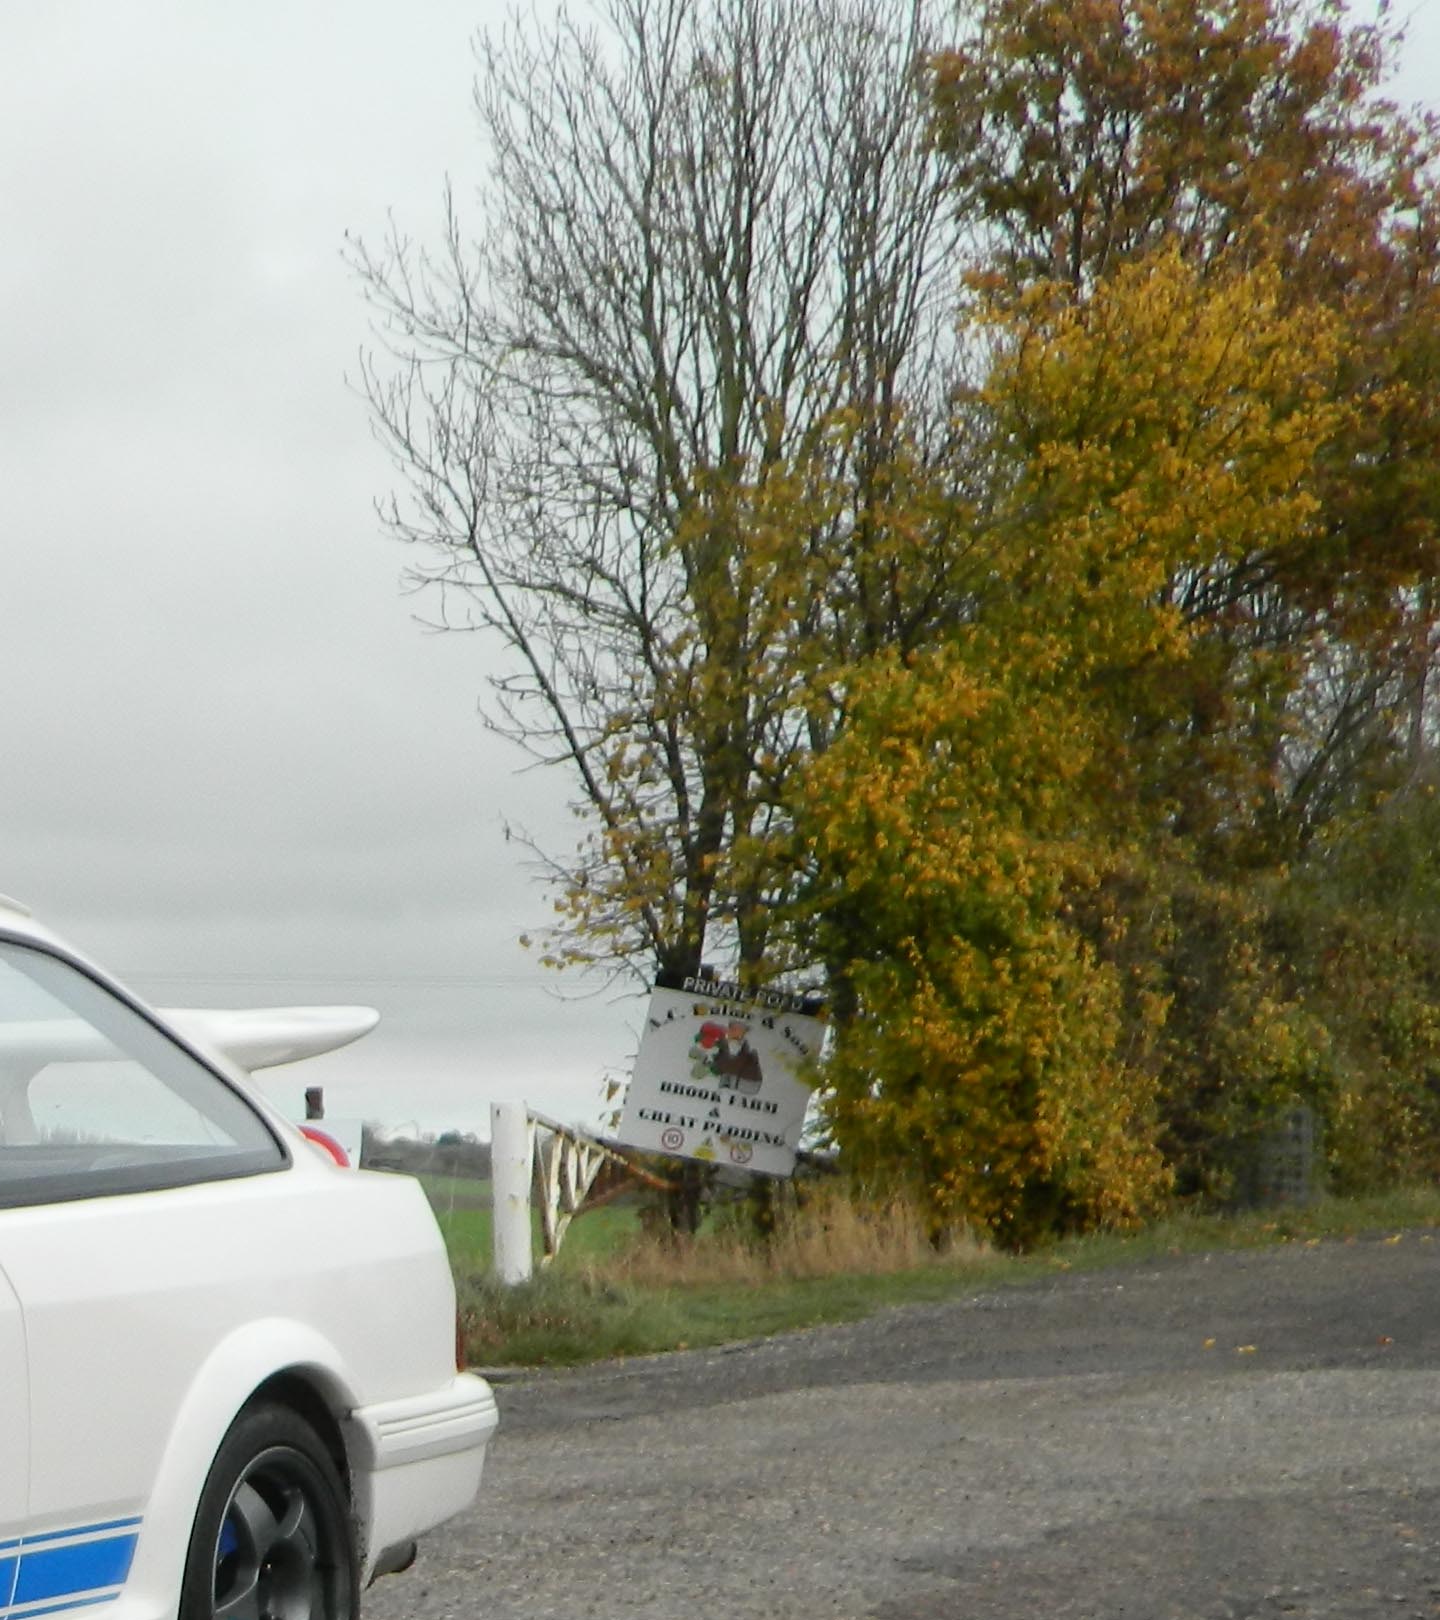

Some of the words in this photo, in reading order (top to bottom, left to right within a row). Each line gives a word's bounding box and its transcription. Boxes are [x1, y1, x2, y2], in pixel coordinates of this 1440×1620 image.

[660, 1081, 721, 1103] BROOK
[728, 1095, 779, 1114] FARM
[638, 1108, 698, 1128] GREAT
[708, 1107, 720, 1118] &
